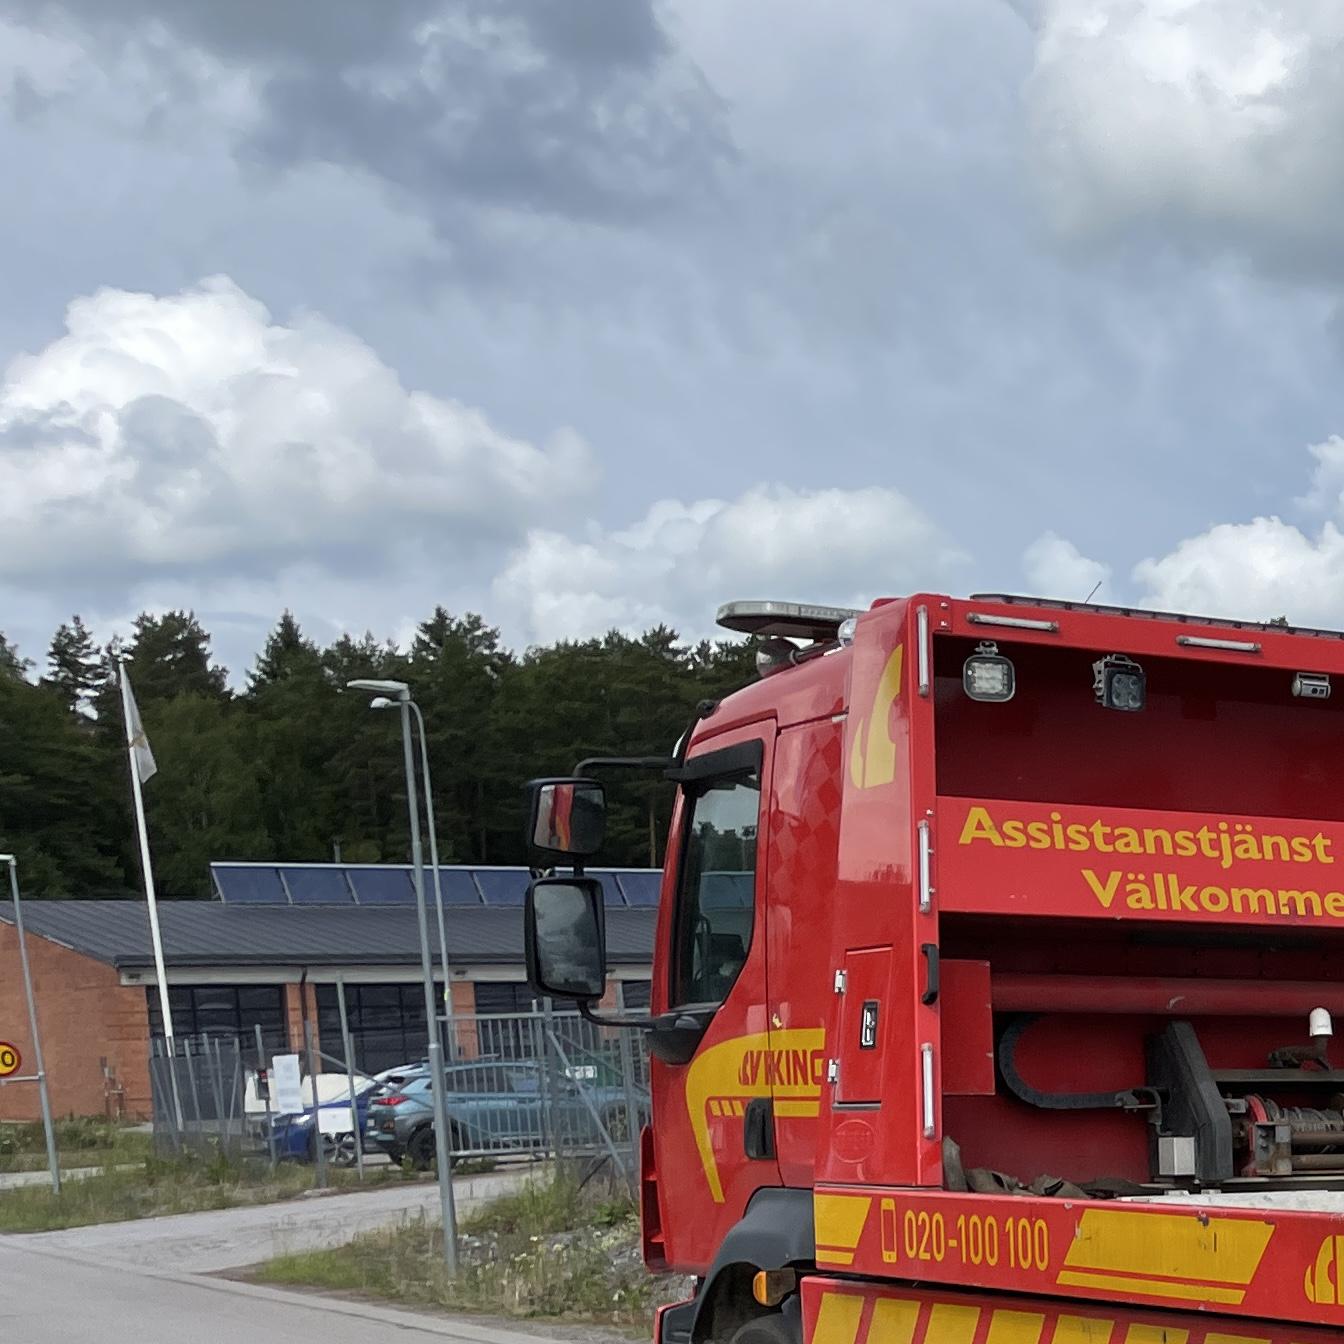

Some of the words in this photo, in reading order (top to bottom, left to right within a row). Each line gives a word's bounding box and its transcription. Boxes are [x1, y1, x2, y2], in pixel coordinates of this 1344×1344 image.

[959, 807, 1334, 869] Assistanstjänst
[904, 1209, 999, 1266] 020-100
[1005, 1216, 1049, 1271] 100
